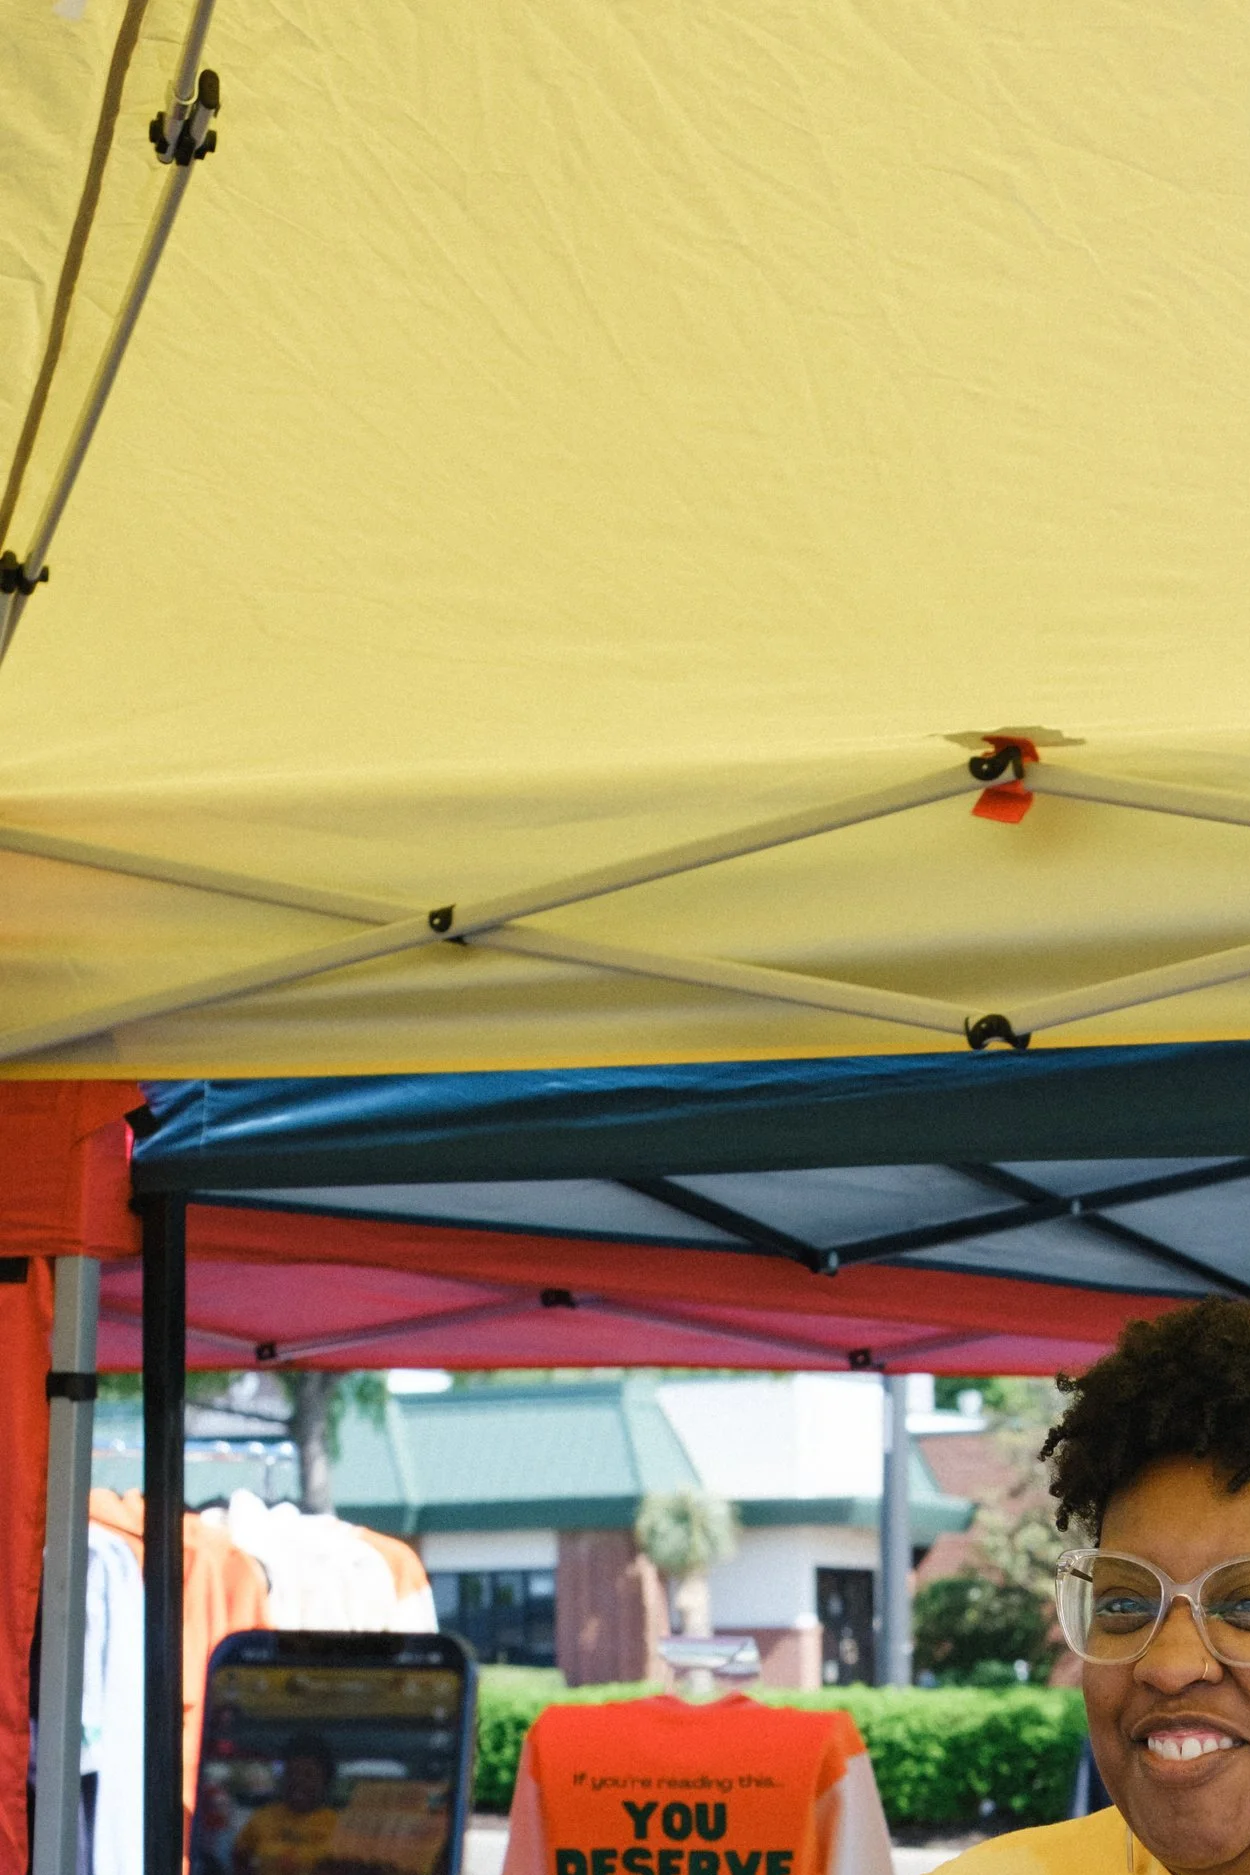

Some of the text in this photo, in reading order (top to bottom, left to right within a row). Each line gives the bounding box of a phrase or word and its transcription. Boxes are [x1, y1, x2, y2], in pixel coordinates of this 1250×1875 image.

[572, 1772, 588, 1787] If
[591, 1775, 653, 1792] you're
[657, 1774, 734, 1793] reading
[622, 1800, 728, 1841] YOU
